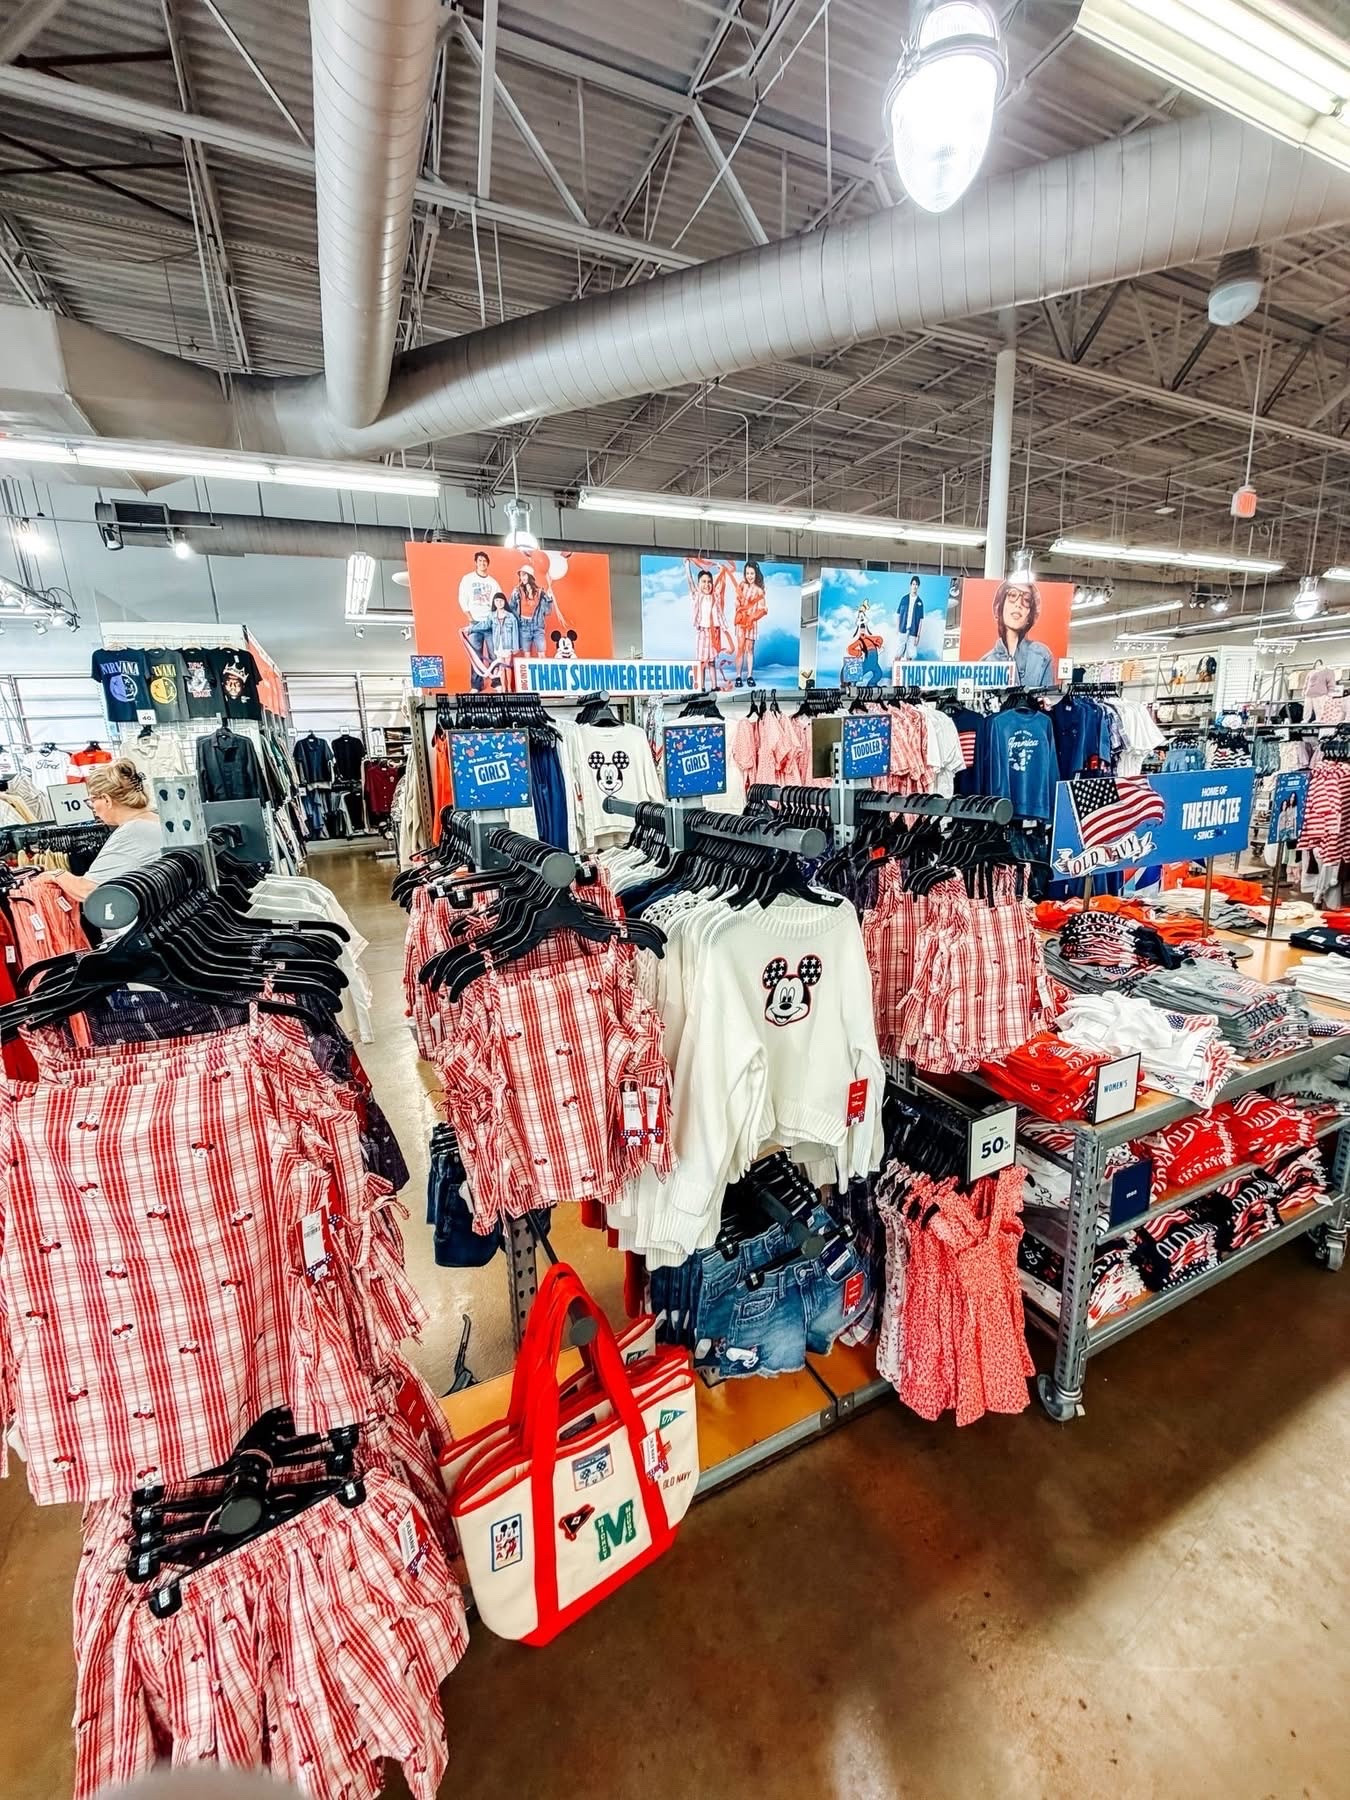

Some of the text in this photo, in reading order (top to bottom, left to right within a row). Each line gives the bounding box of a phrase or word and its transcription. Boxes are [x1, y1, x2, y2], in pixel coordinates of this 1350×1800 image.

[100, 661, 140, 676] NIRVANA
[528, 664, 699, 691] THAT SUMMER FEELING!
[902, 665, 927, 686] THAT
[974, 666, 1013, 686] FEELING!
[853, 740, 881, 758] TODDLER
[35, 760, 60, 770] Ford
[477, 762, 508, 783] GIRLS
[684, 754, 708, 773] GIRLS
[1202, 786, 1228, 797] HOME OF
[1182, 797, 1242, 830] THE FLAG TEE
[1073, 835, 1136, 875] OLD NAVY
[1103, 1079, 1128, 1094] WOMEN'S
[980, 1136, 1004, 1159] 50
[1156, 1231, 1191, 1259] OLD
[676, 1471, 692, 1484] NAVY
